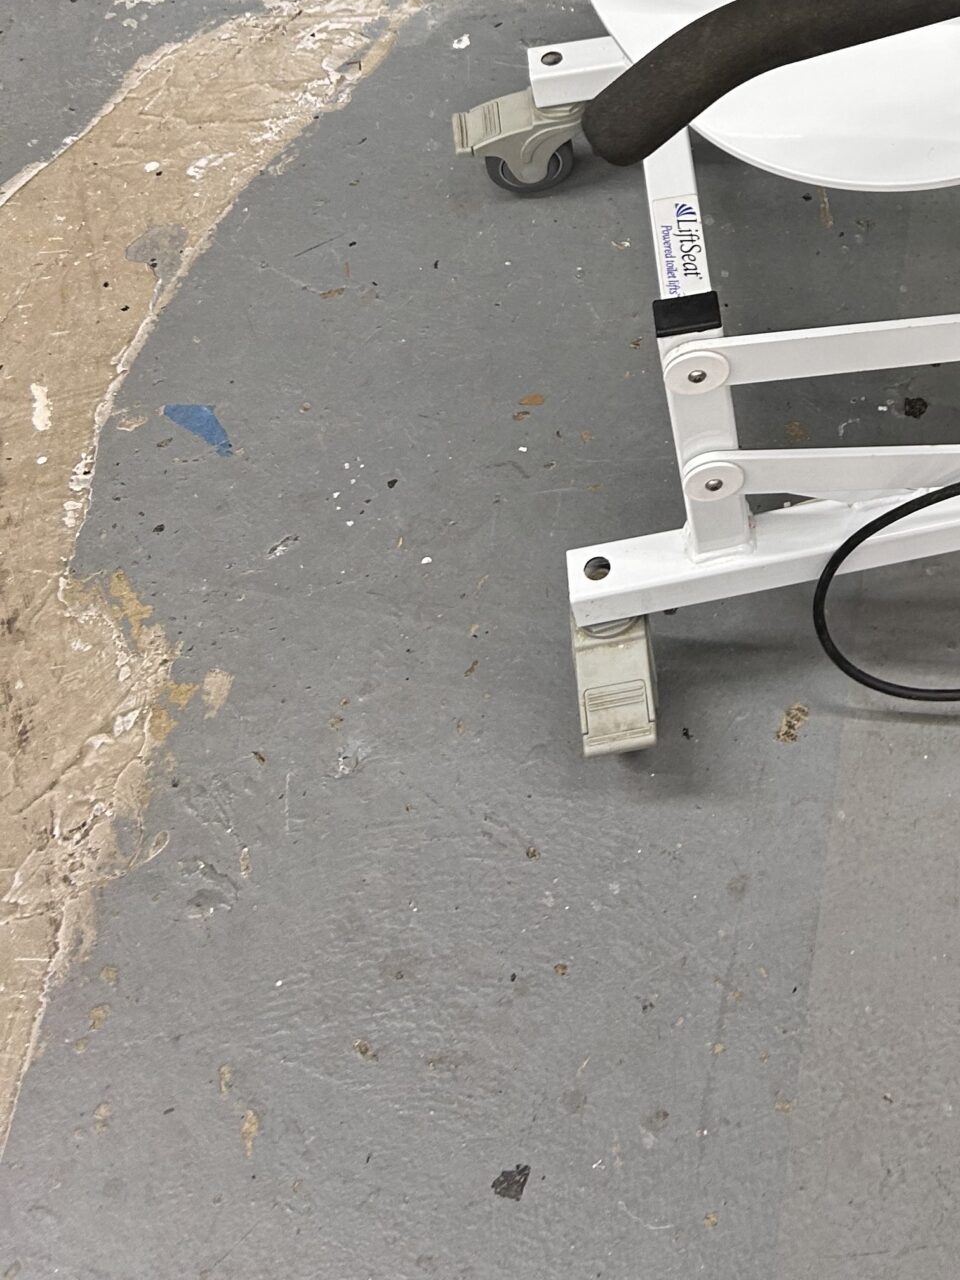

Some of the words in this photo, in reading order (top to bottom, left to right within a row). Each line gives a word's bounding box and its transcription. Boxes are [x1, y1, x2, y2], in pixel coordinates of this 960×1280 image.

[660, 225, 675, 259] Powered
[673, 219, 702, 278] LiftSeat
[665, 259, 678, 280] toilet
